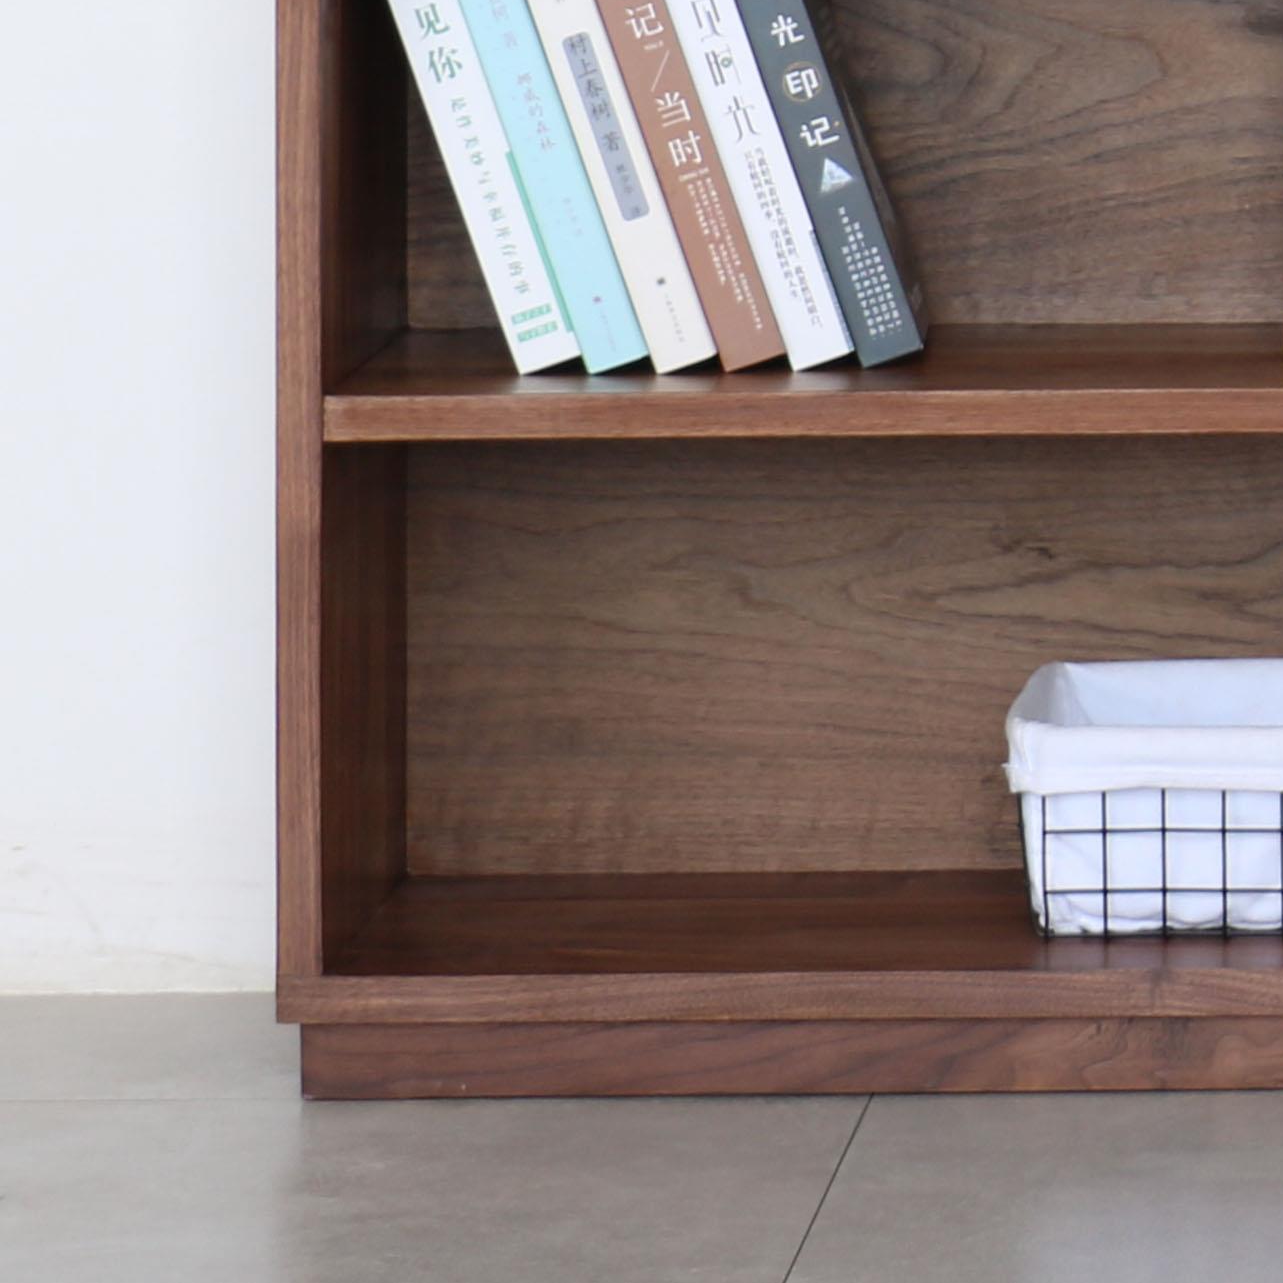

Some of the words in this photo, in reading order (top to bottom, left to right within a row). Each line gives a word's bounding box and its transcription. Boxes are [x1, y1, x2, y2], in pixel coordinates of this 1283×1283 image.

[565, 32, 613, 123] 村上春树
[601, 130, 622, 154] 著
[655, 91, 701, 169] 当时
